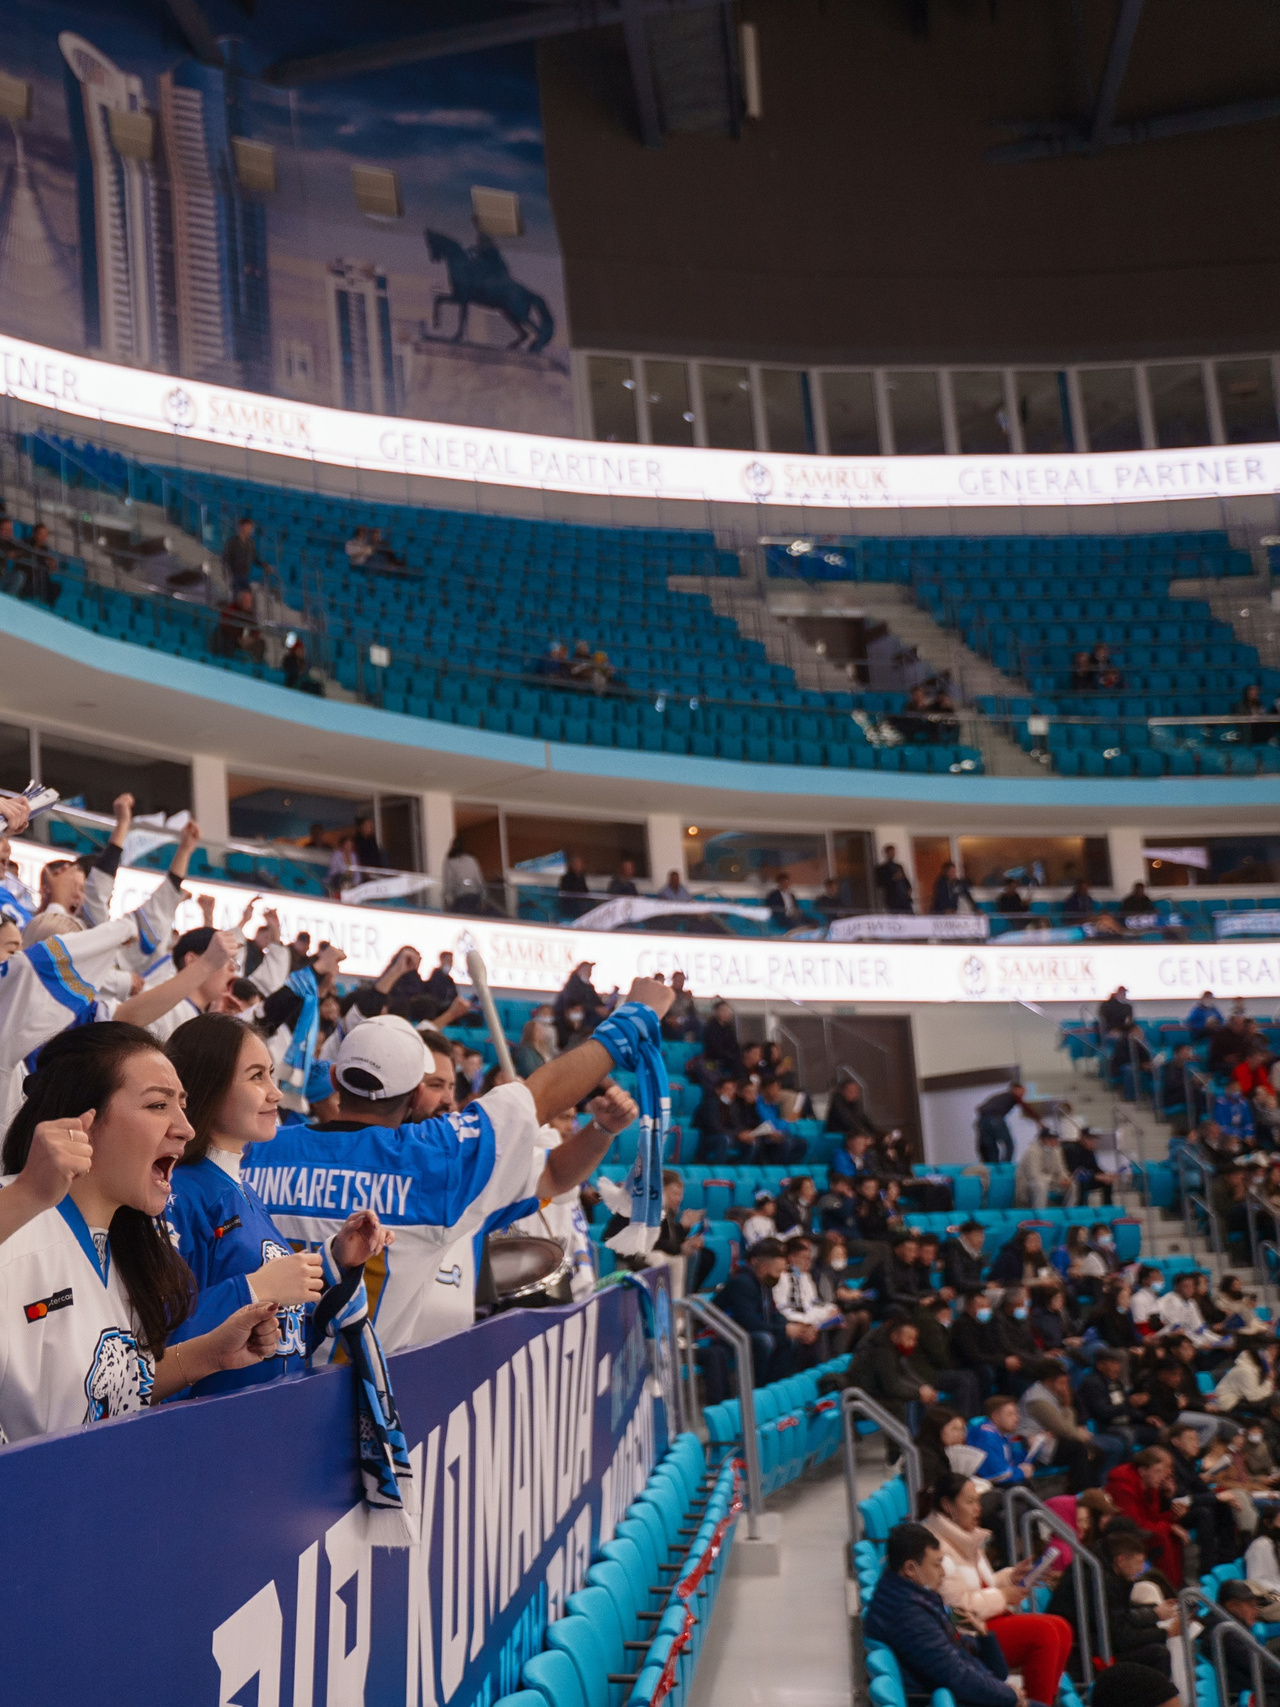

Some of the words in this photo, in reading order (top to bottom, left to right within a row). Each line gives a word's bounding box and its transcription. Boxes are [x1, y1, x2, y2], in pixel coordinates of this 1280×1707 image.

[208, 397, 311, 440] SAMRUK
[379, 430, 518, 475] GENERAL
[529, 449, 663, 487] PARTNER
[784, 466, 888, 490] SAMRUK
[958, 466, 1103, 496] GENERAL
[1114, 457, 1265, 490] PARTNER
[280, 909, 382, 960] ARTNER
[490, 936, 574, 968] SAMRUK
[490, 969, 561, 984] KAZYN
[635, 950, 758, 985] GENERAL
[769, 956, 892, 988] PARTNER
[998, 958, 1096, 980] SAMRUK
[1158, 956, 1280, 986] GENERA
